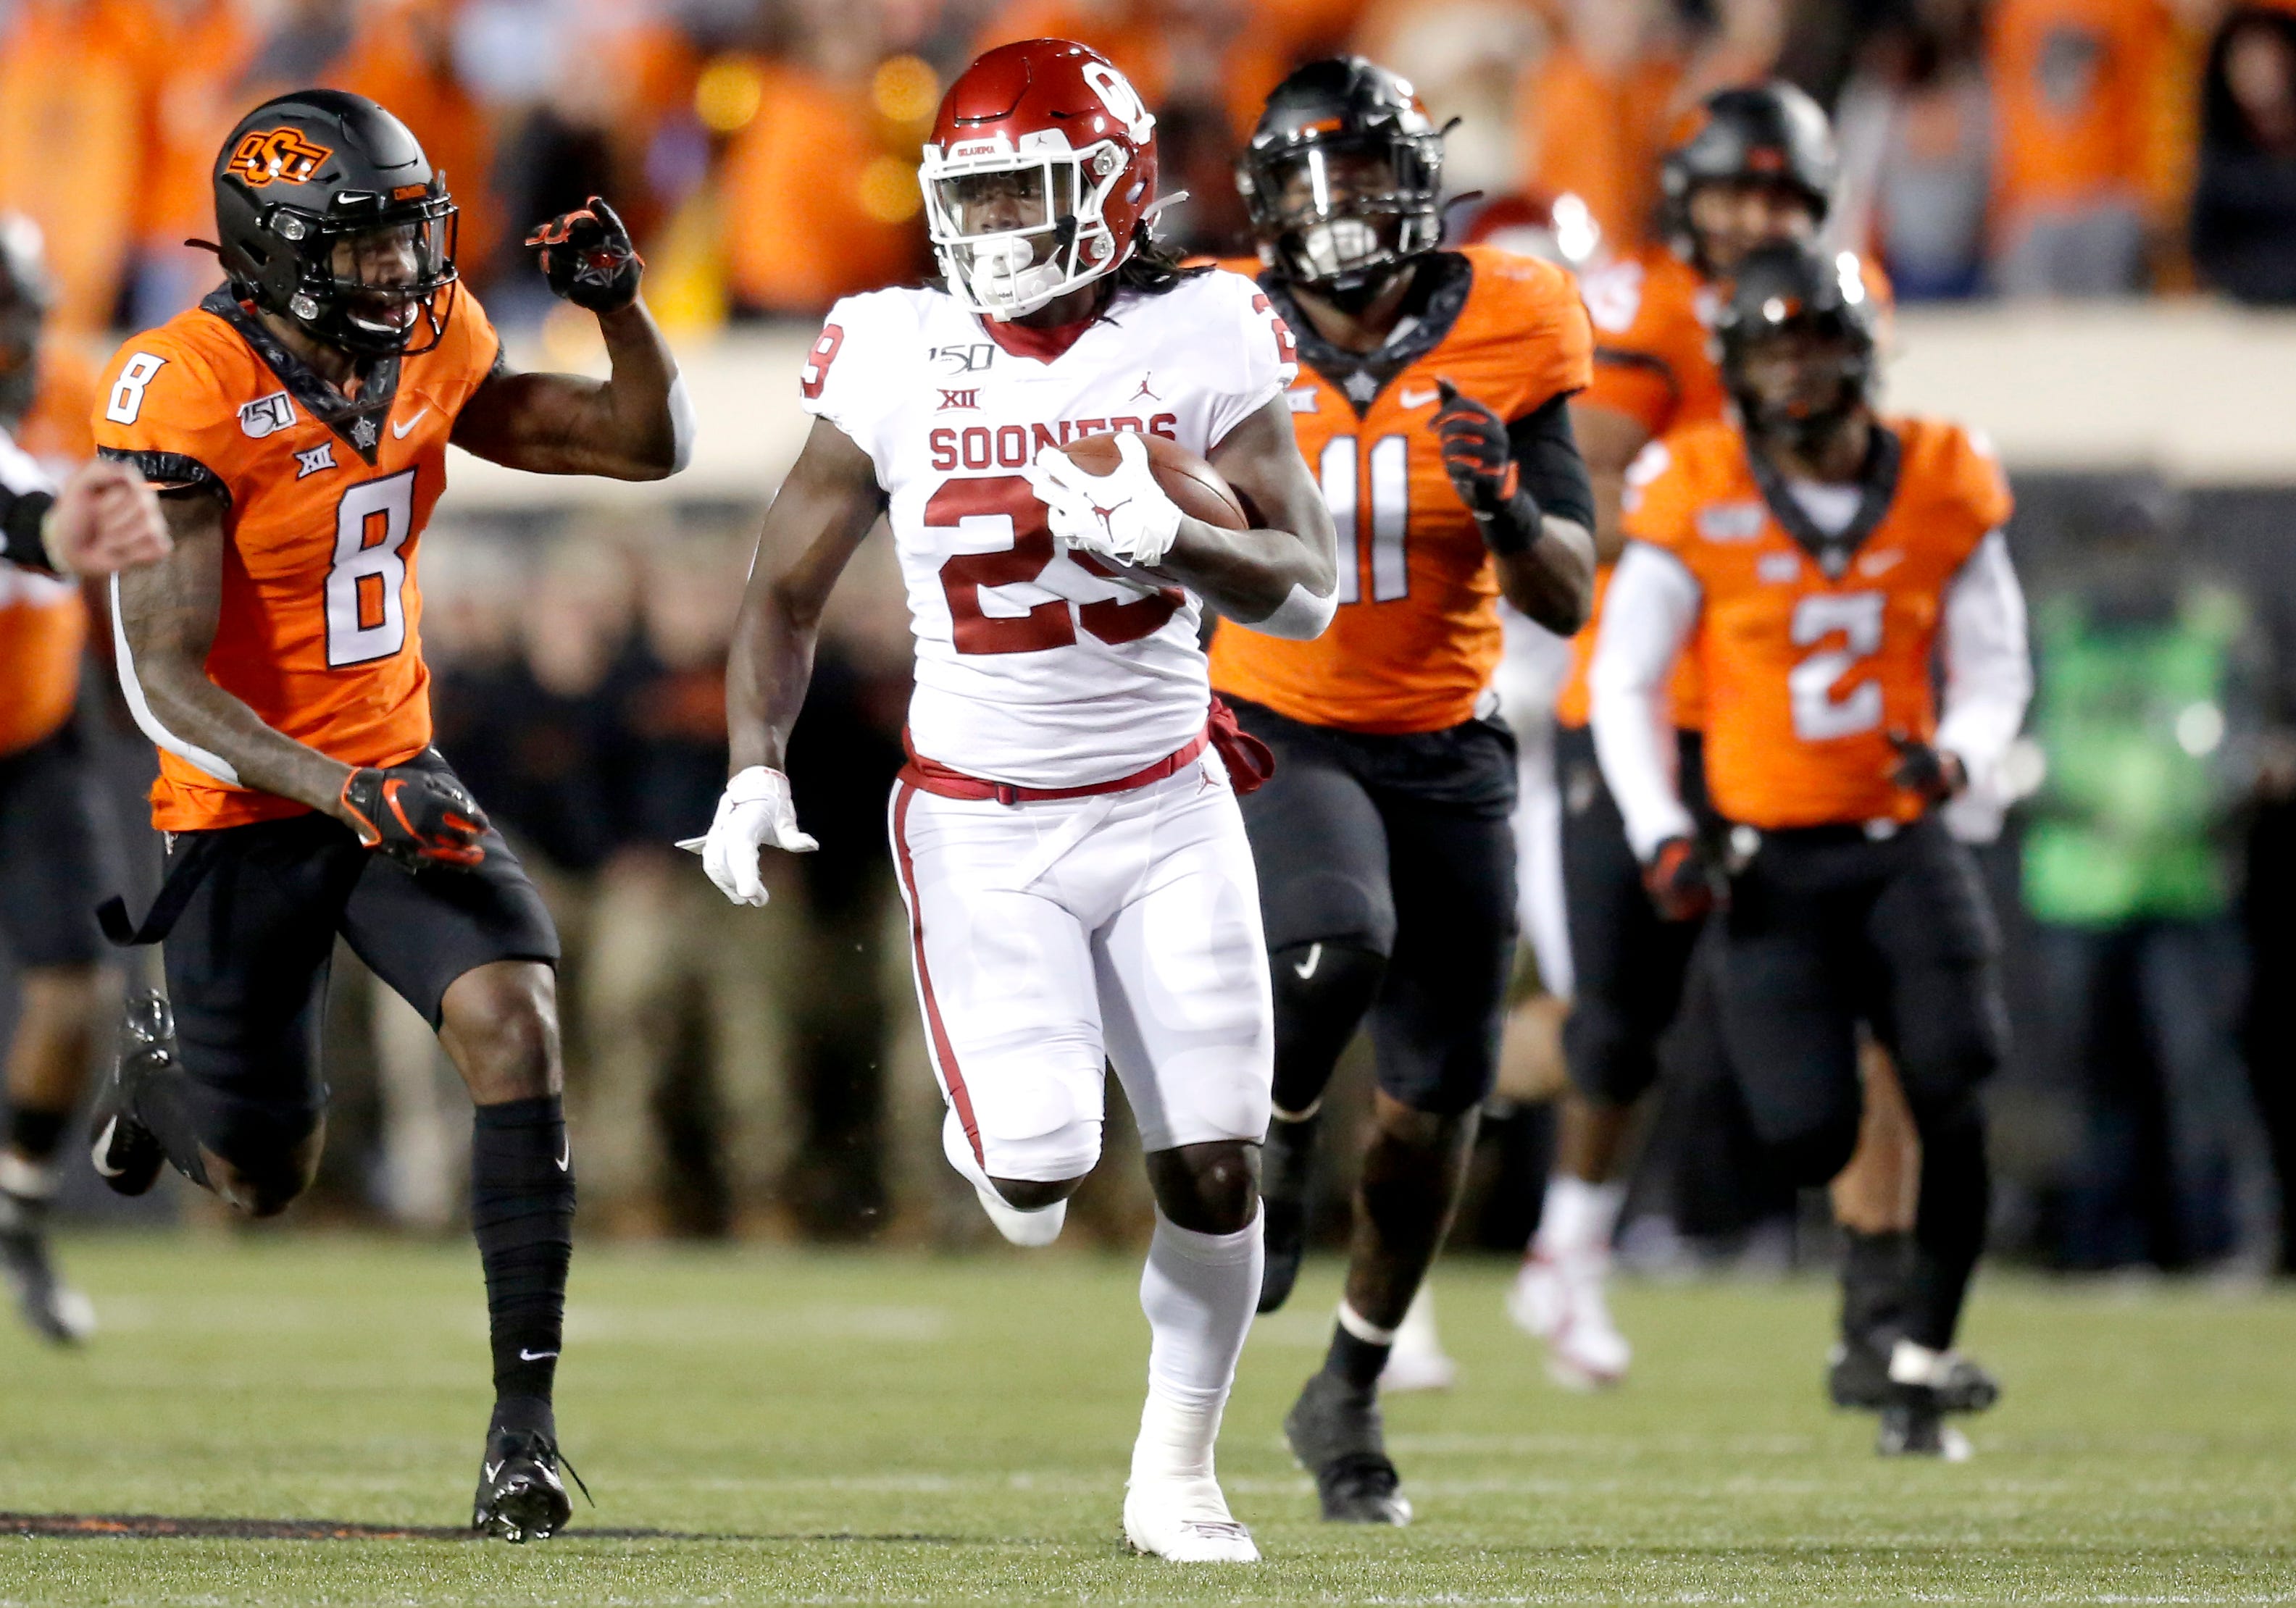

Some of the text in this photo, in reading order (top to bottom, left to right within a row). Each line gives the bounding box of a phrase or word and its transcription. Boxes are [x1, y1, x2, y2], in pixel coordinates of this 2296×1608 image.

[957, 146, 995, 157] OKLAHOMA
[105, 351, 169, 426] 8
[800, 323, 845, 400] 9
[928, 343, 995, 376] 150
[238, 391, 296, 437] 150
[936, 388, 981, 411] XII
[293, 439, 338, 481] XII
[1319, 435, 1409, 605] 11
[323, 465, 418, 669] 8
[1788, 590, 1887, 741] 2
